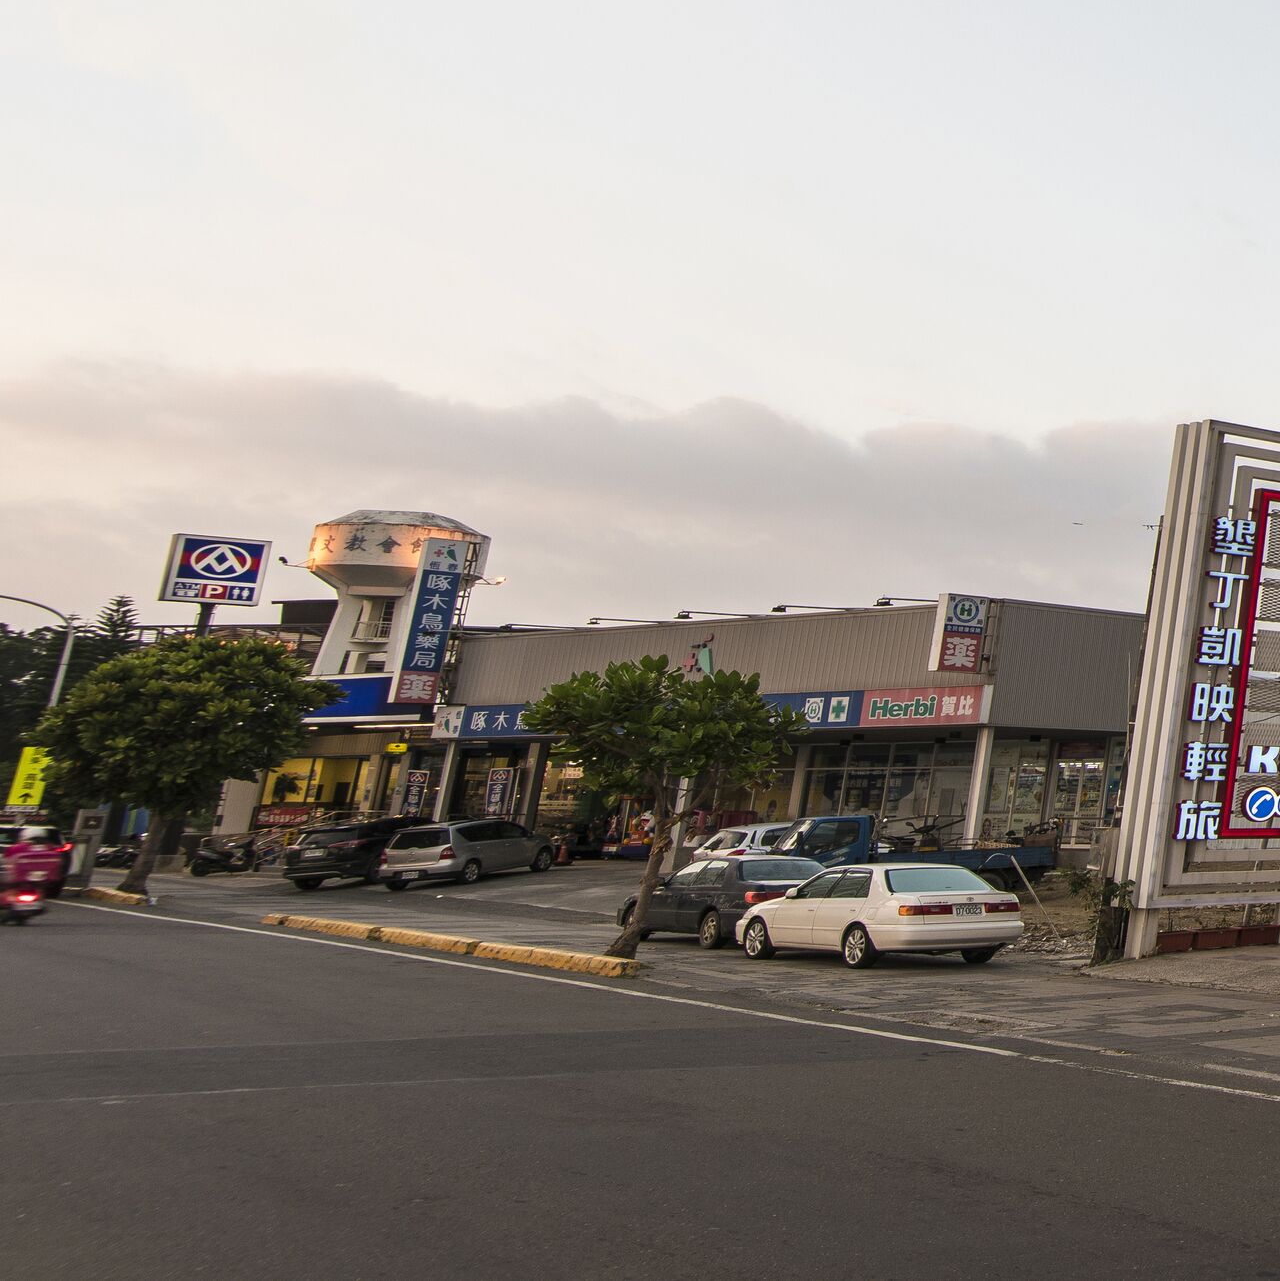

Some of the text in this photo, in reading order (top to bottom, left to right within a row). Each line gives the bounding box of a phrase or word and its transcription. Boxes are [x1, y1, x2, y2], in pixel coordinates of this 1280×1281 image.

[205, 585, 224, 598] P
[410, 574, 454, 669] 啄木鳥藥局
[869, 694, 975, 720] Herbi 賀比
[1173, 516, 1257, 841] 墾丁凱映輕旅
